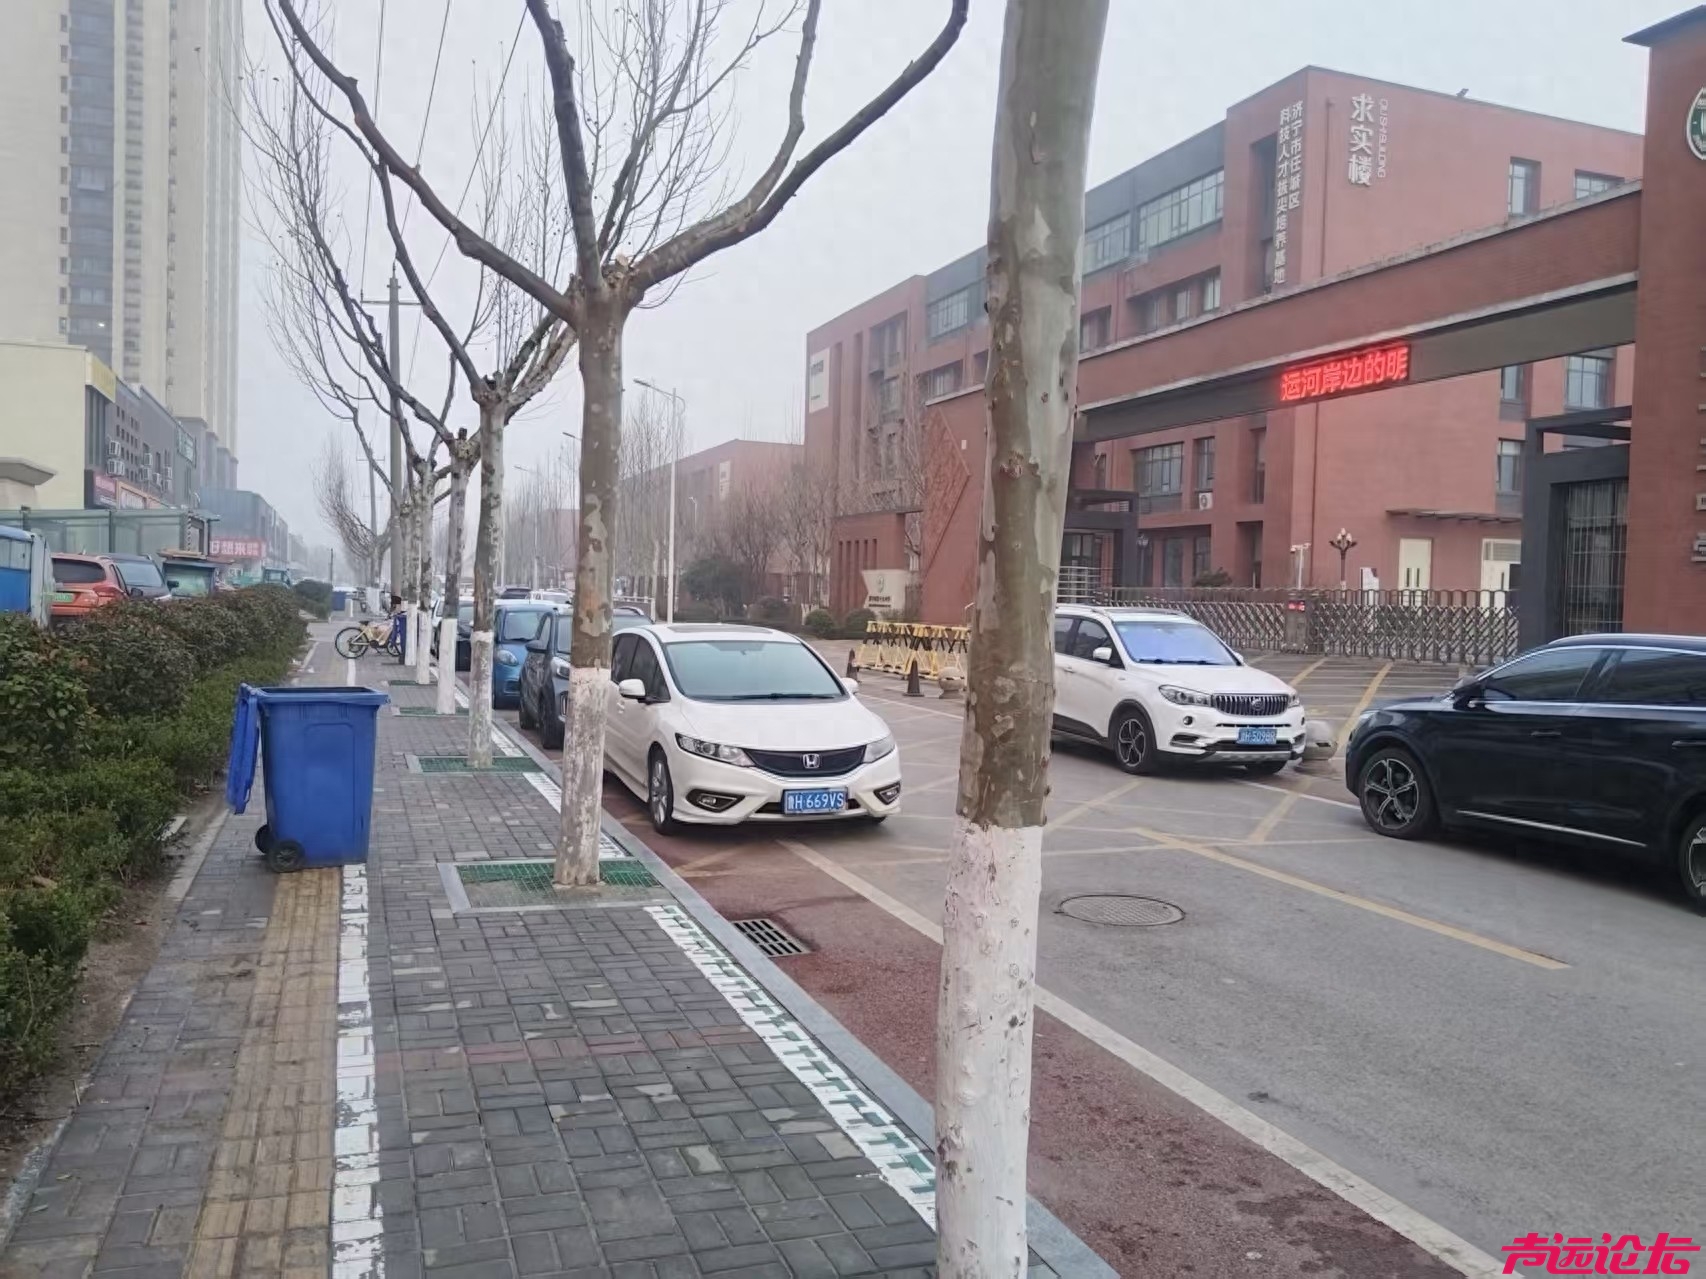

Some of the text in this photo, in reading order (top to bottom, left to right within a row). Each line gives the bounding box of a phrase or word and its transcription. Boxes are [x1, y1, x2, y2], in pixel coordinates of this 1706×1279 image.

[1288, 100, 1303, 210] 济宁市任城区
[1348, 93, 1374, 186] 求实楼
